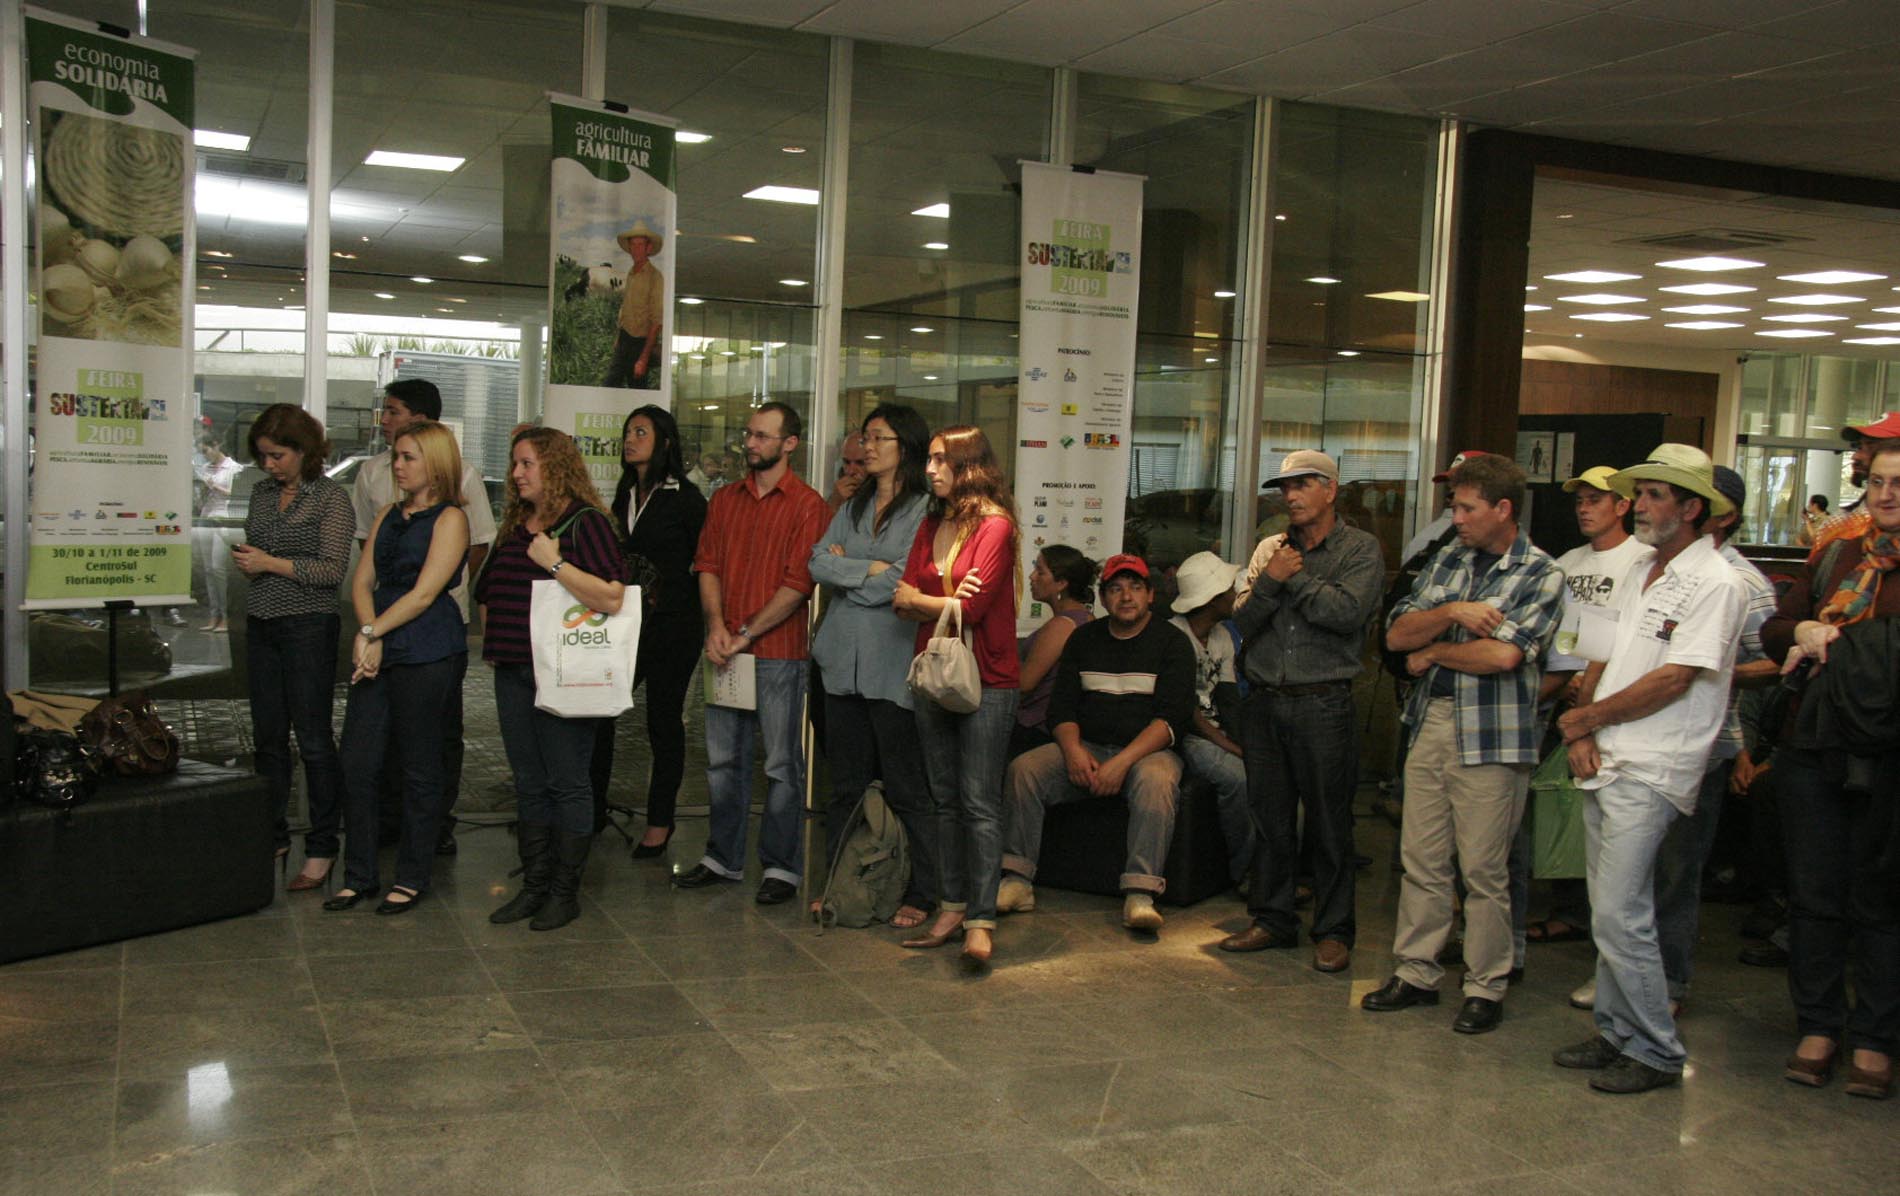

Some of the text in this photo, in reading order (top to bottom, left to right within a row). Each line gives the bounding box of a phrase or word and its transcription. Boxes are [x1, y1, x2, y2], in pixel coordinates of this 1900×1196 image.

[64, 43, 160, 80] economia
[575, 121, 652, 149] agricultura
[576, 138, 650, 168] FAMILIAR
[1059, 221, 1103, 240] FEIRA
[1058, 275, 1103, 297] 2009
[86, 369, 137, 389] FEIRA
[86, 424, 138, 446] 2009
[52, 548, 84, 558] 30/10
[100, 547, 122, 558] 1/11
[127, 547, 139, 557] de
[143, 547, 167, 557] 2009
[86, 561, 137, 571] CentroSul
[65, 575, 134, 586] Florianópolis
[144, 574, 157, 583] SC
[562, 627, 611, 646] ideal
